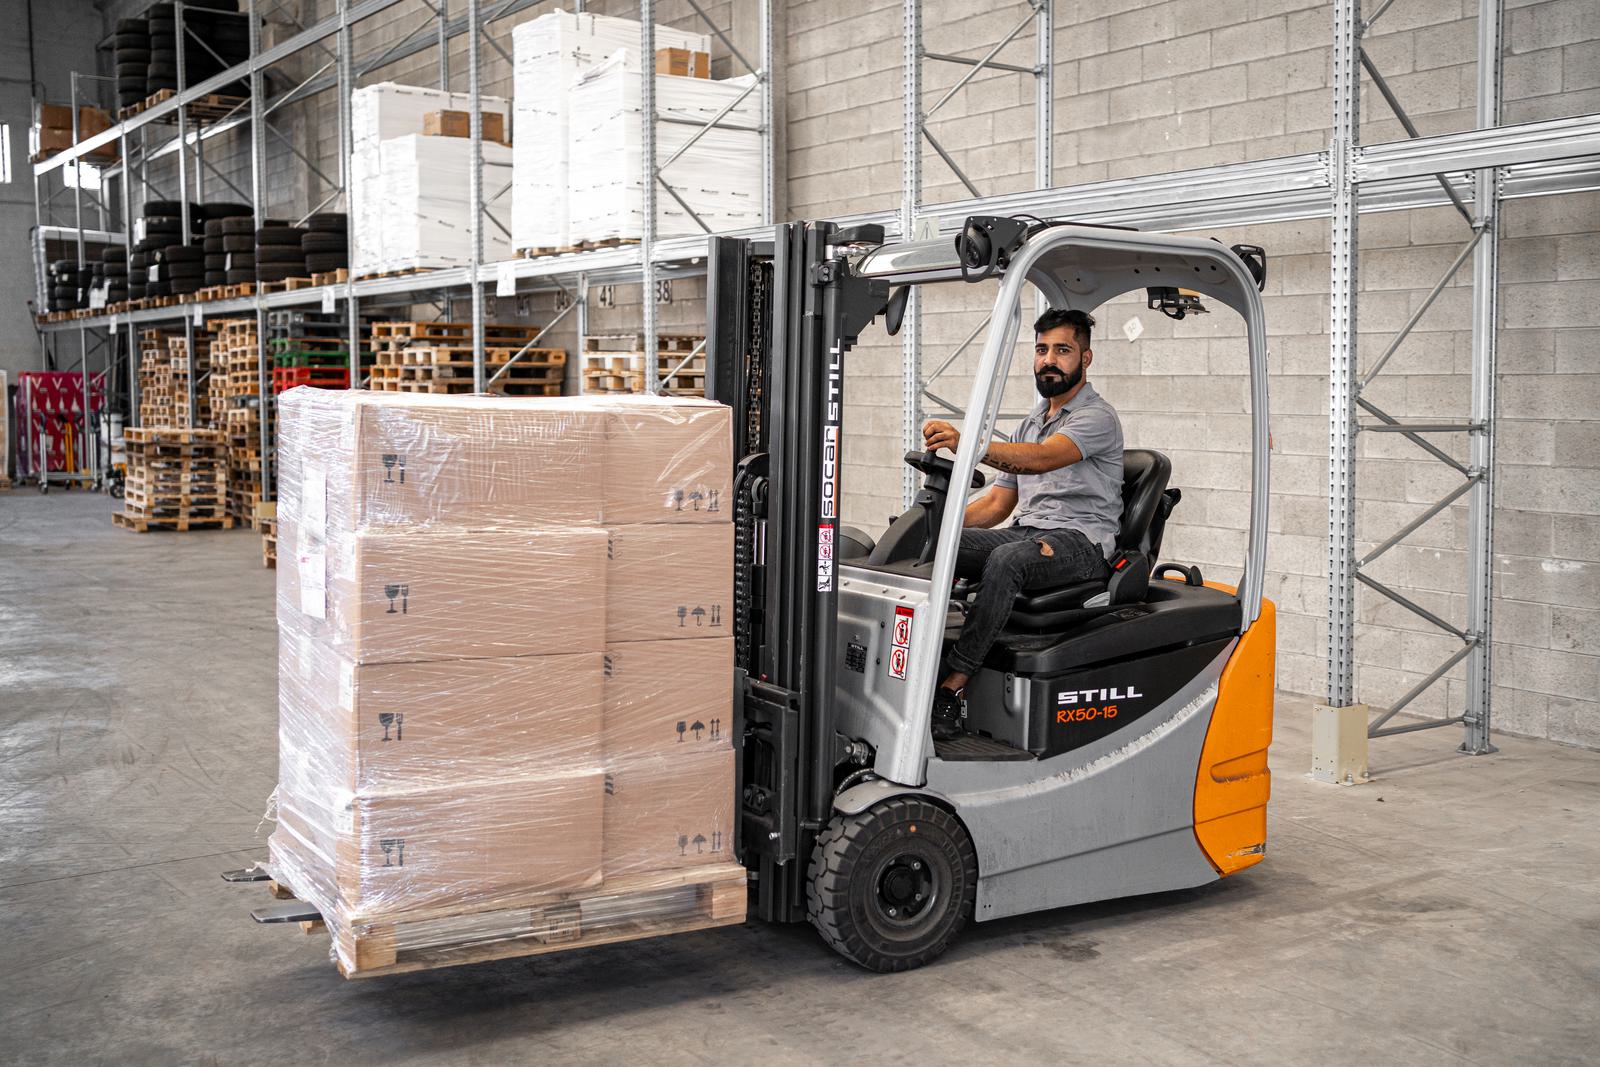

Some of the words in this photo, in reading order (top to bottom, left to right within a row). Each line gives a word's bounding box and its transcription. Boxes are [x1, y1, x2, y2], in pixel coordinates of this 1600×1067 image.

[599, 285, 613, 306] 41
[828, 338, 841, 421] STILL
[1057, 686, 1143, 705] STILL
[1056, 705, 1118, 724] RX50-15
